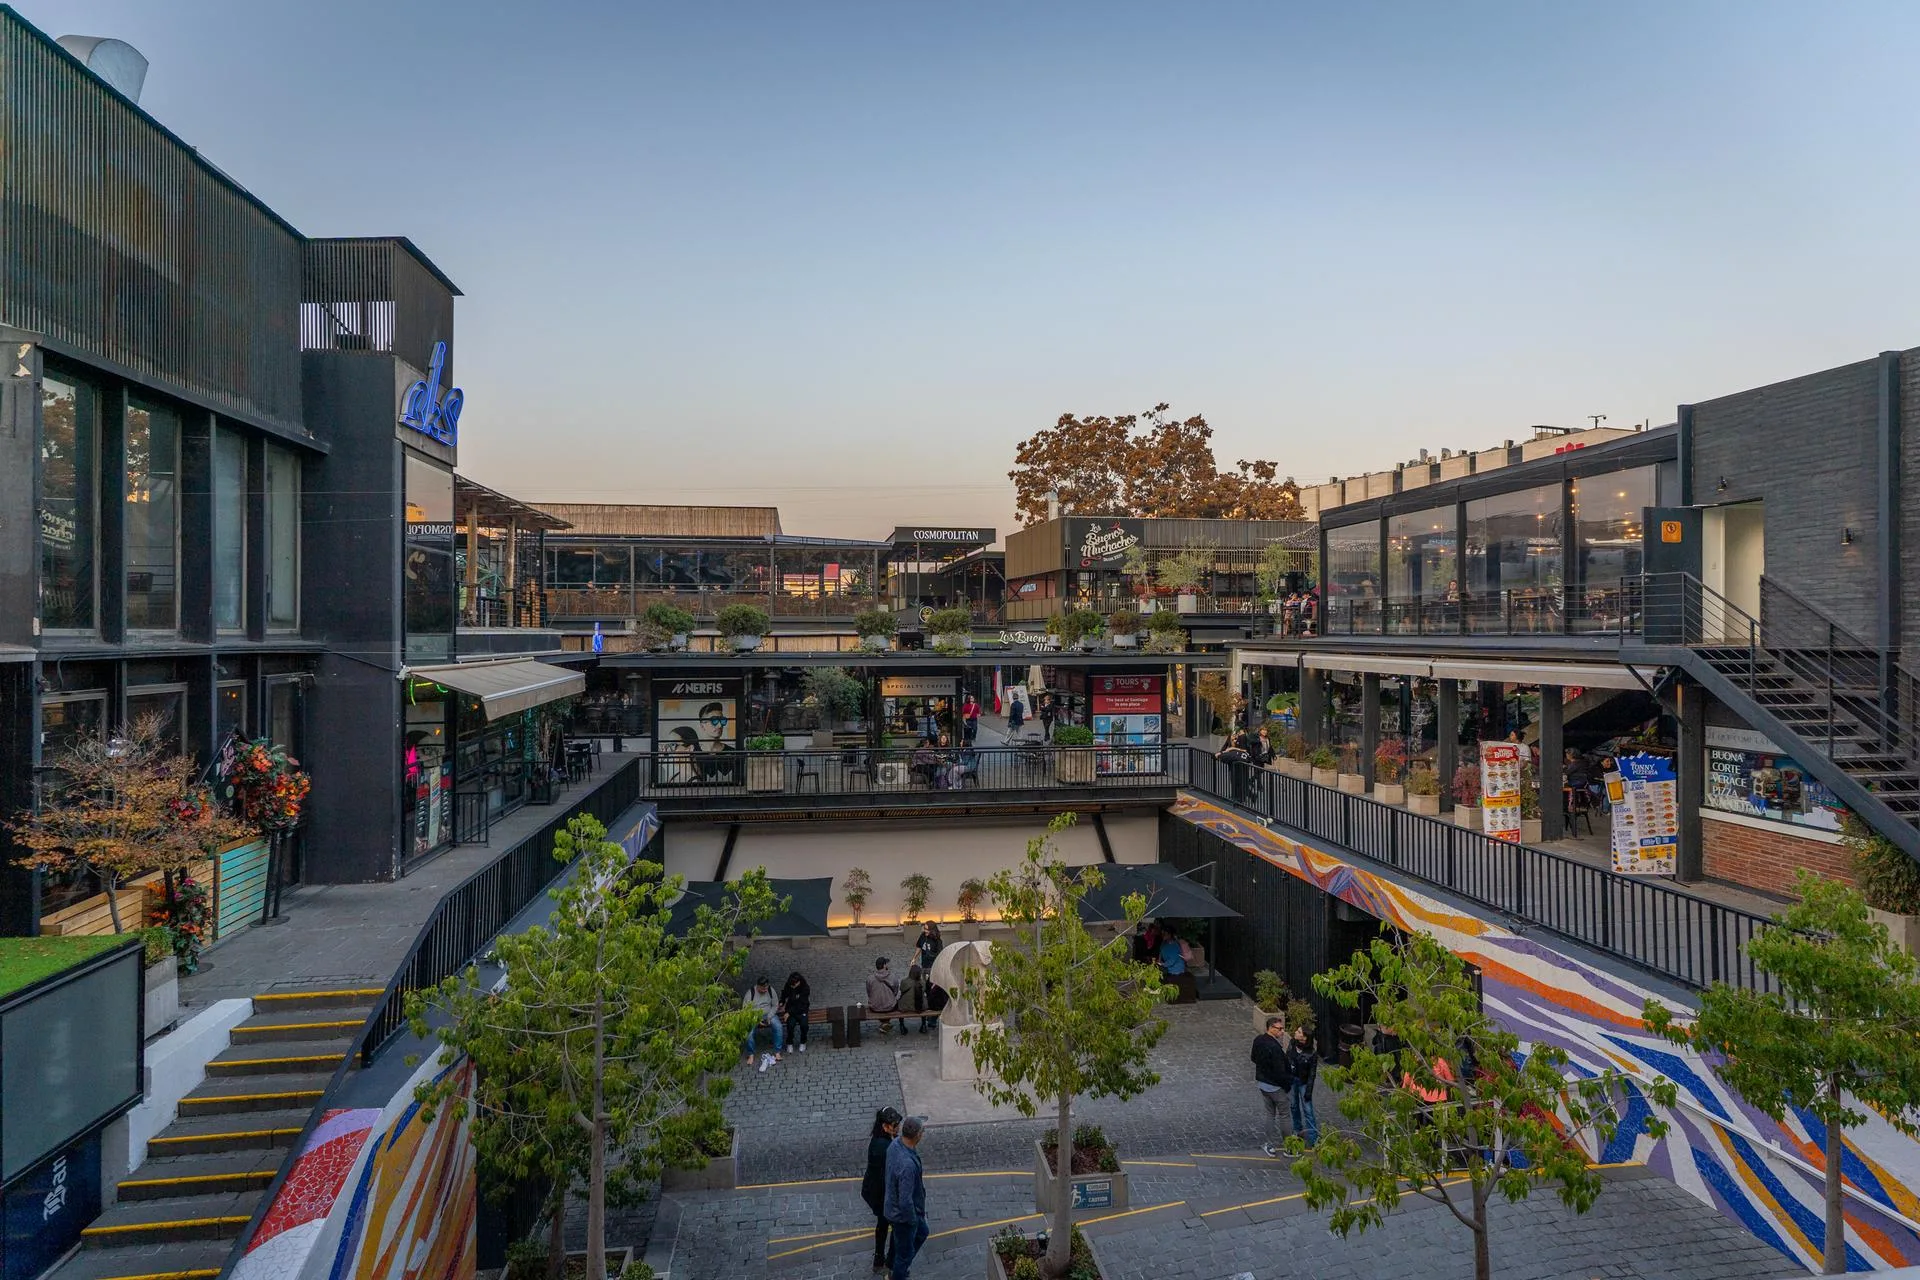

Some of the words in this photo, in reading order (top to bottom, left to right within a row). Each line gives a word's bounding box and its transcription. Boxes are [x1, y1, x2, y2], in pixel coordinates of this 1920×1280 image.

[1089, 522, 1102, 534] Los
[913, 530, 979, 540] COSMOPOLITAN
[1085, 527, 1125, 545] Buenos
[1080, 534, 1139, 557] Muchachos
[999, 630, 1014, 645] Los
[1116, 678, 1140, 686] TOURS
[685, 683, 723, 694] NERFIS
[1712, 750, 1744, 763] BUONA
[1631, 763, 1655, 771] TONNY
[1712, 762, 1741, 775] CORTE
[1711, 773, 1747, 788] VERACE
[1712, 786, 1738, 798] PIZZA
